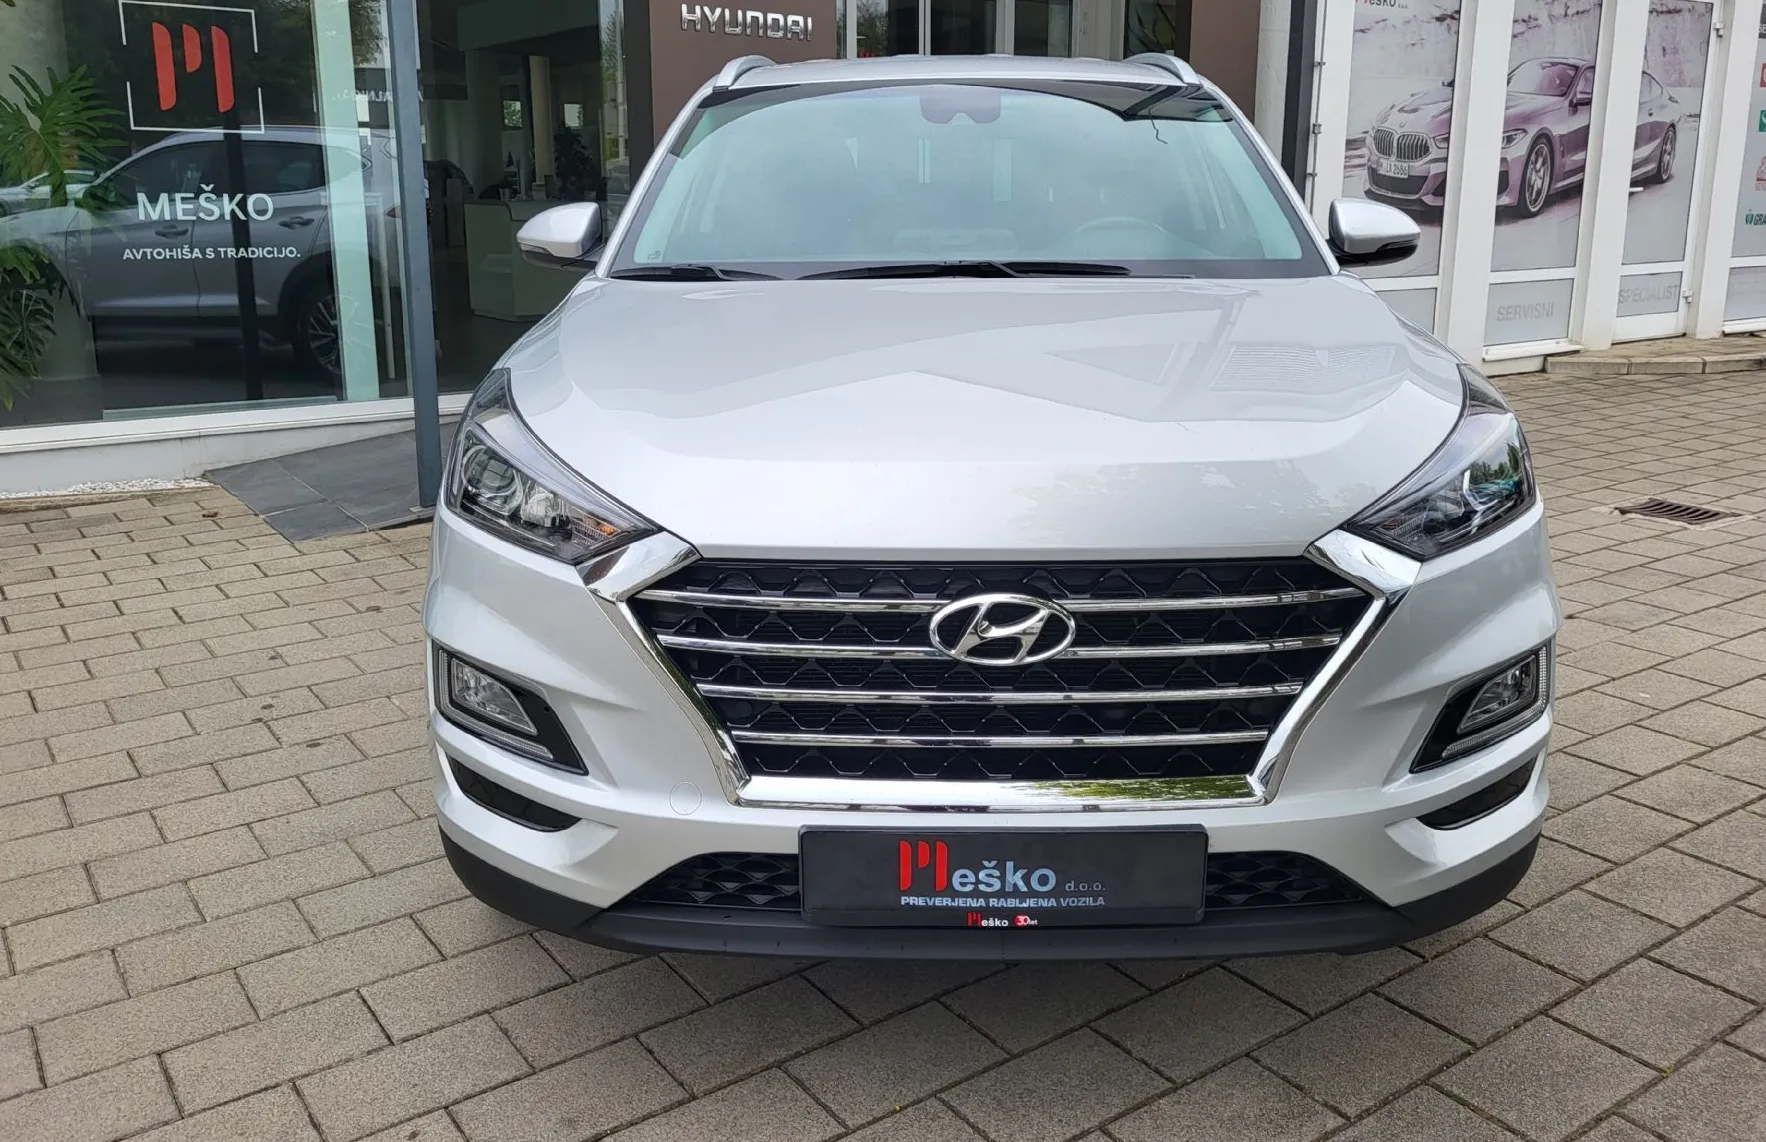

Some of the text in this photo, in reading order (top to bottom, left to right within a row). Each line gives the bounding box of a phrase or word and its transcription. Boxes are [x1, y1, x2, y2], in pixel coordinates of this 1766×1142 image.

[681, 3, 813, 41] HYUNDAI
[136, 183, 274, 221] MEŠKO
[122, 244, 301, 260] AVTOHIŠA S TRADICIJO.
[1618, 285, 1680, 304] SPECIALIST
[1496, 302, 1555, 322] SERVISNI
[1065, 880, 1106, 892] d.o.o.
[900, 896, 1105, 907] PREVERJENA RABLJENA VOZILA
